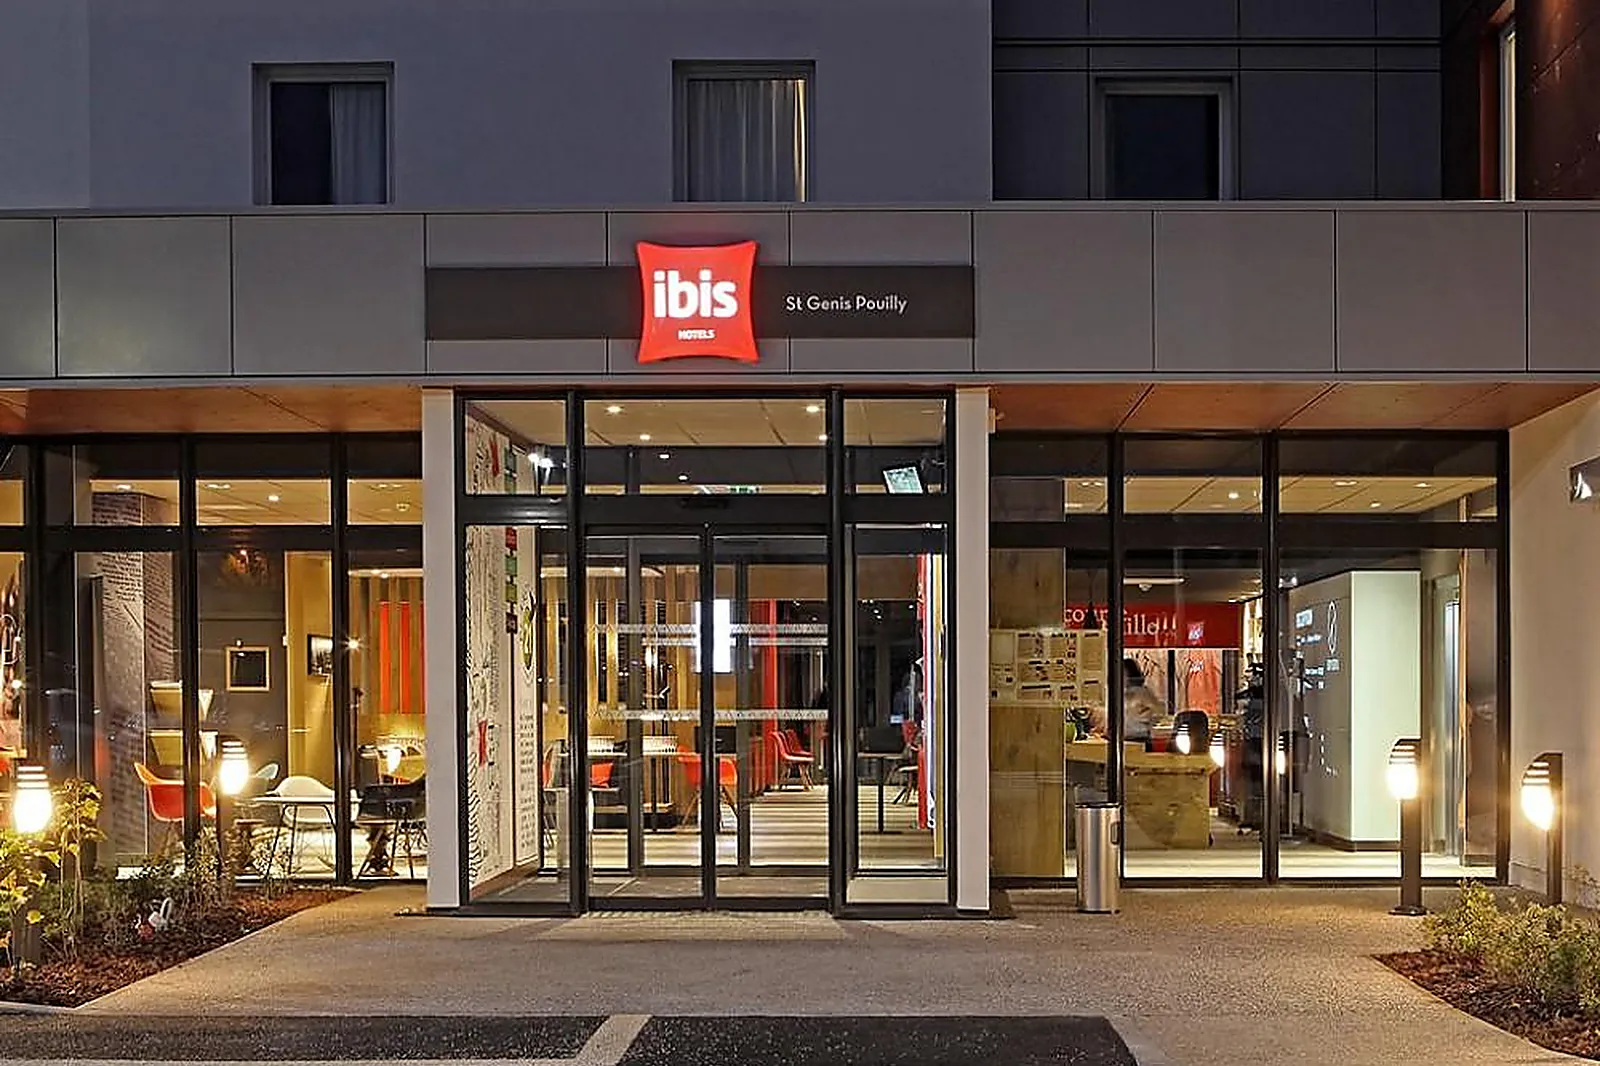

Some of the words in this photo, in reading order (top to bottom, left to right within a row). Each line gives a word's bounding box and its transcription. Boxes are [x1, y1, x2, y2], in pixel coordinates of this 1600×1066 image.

[653, 269, 739, 318] ibis
[786, 295, 803, 311] St
[806, 295, 852, 311] Genis
[855, 295, 908, 315] Pouilly
[677, 329, 716, 341] HOTELS
